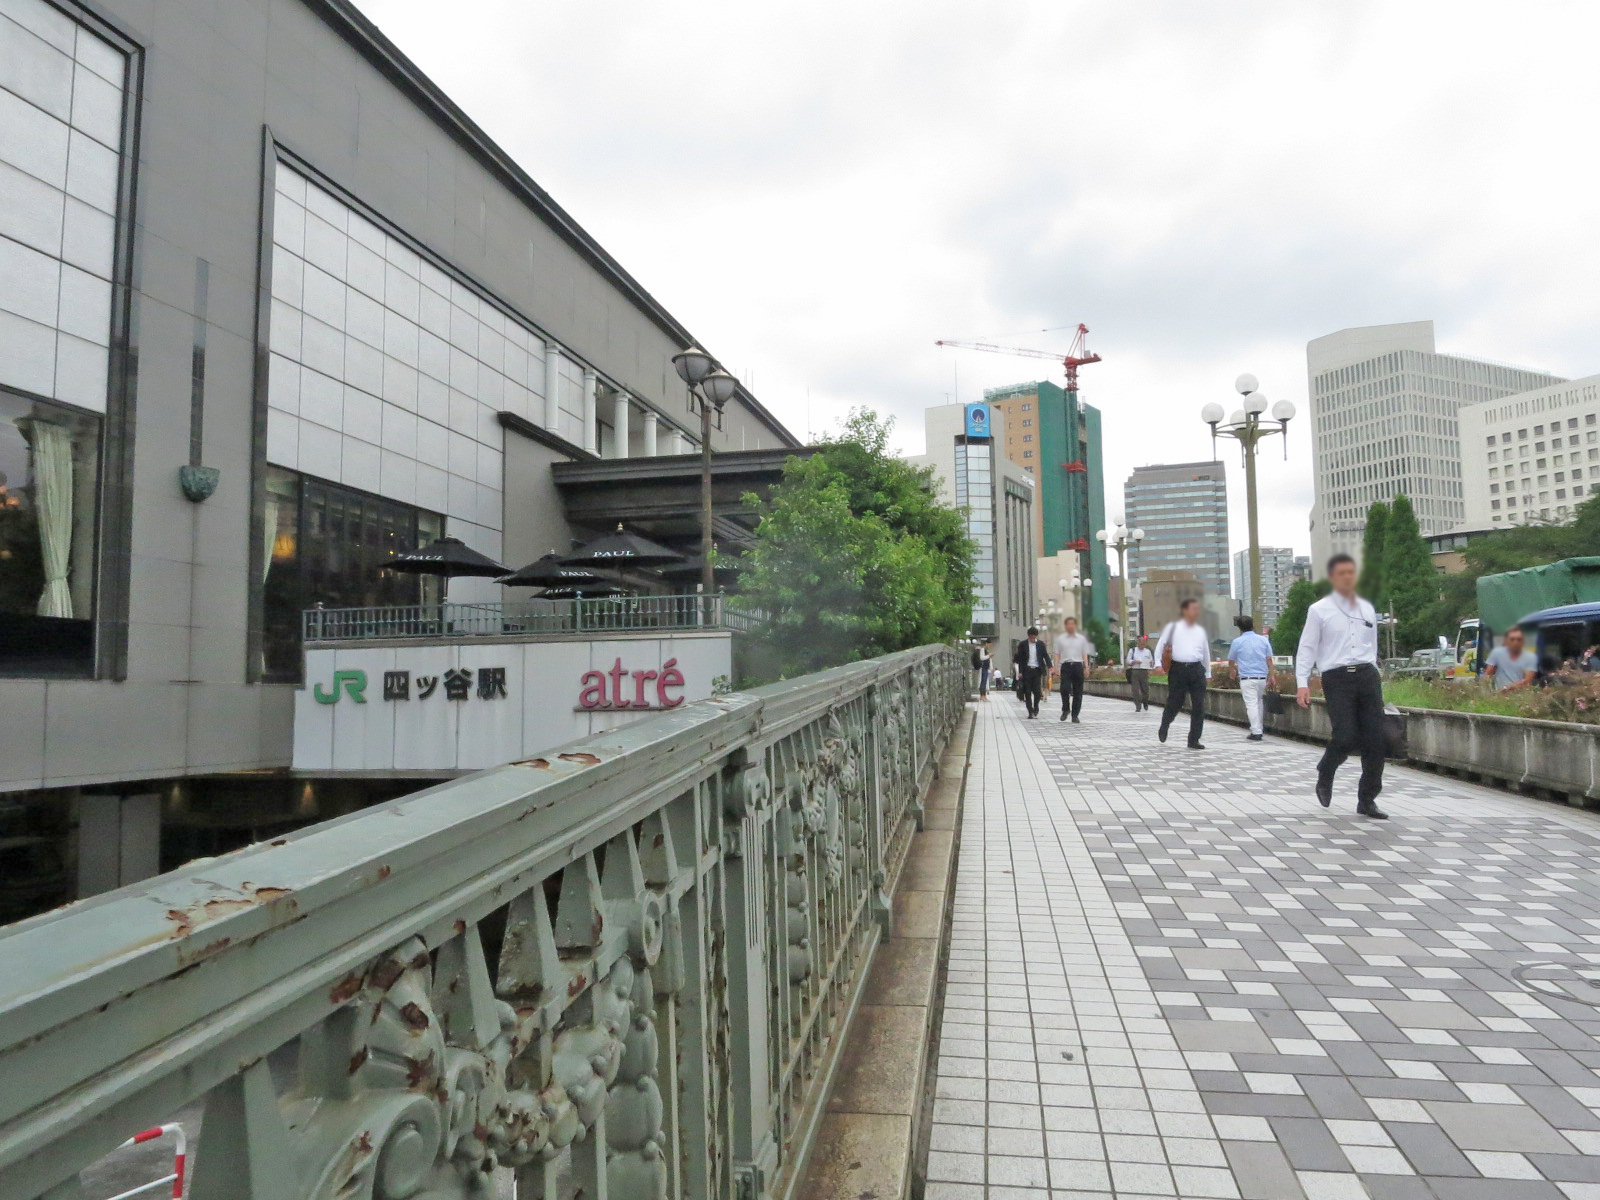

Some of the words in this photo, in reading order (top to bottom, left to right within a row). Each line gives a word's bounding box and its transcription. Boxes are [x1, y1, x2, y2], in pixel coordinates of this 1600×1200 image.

[314, 670, 367, 704] JR
[383, 667, 508, 701] 四ツ谷駅
[579, 657, 685, 708] atré
